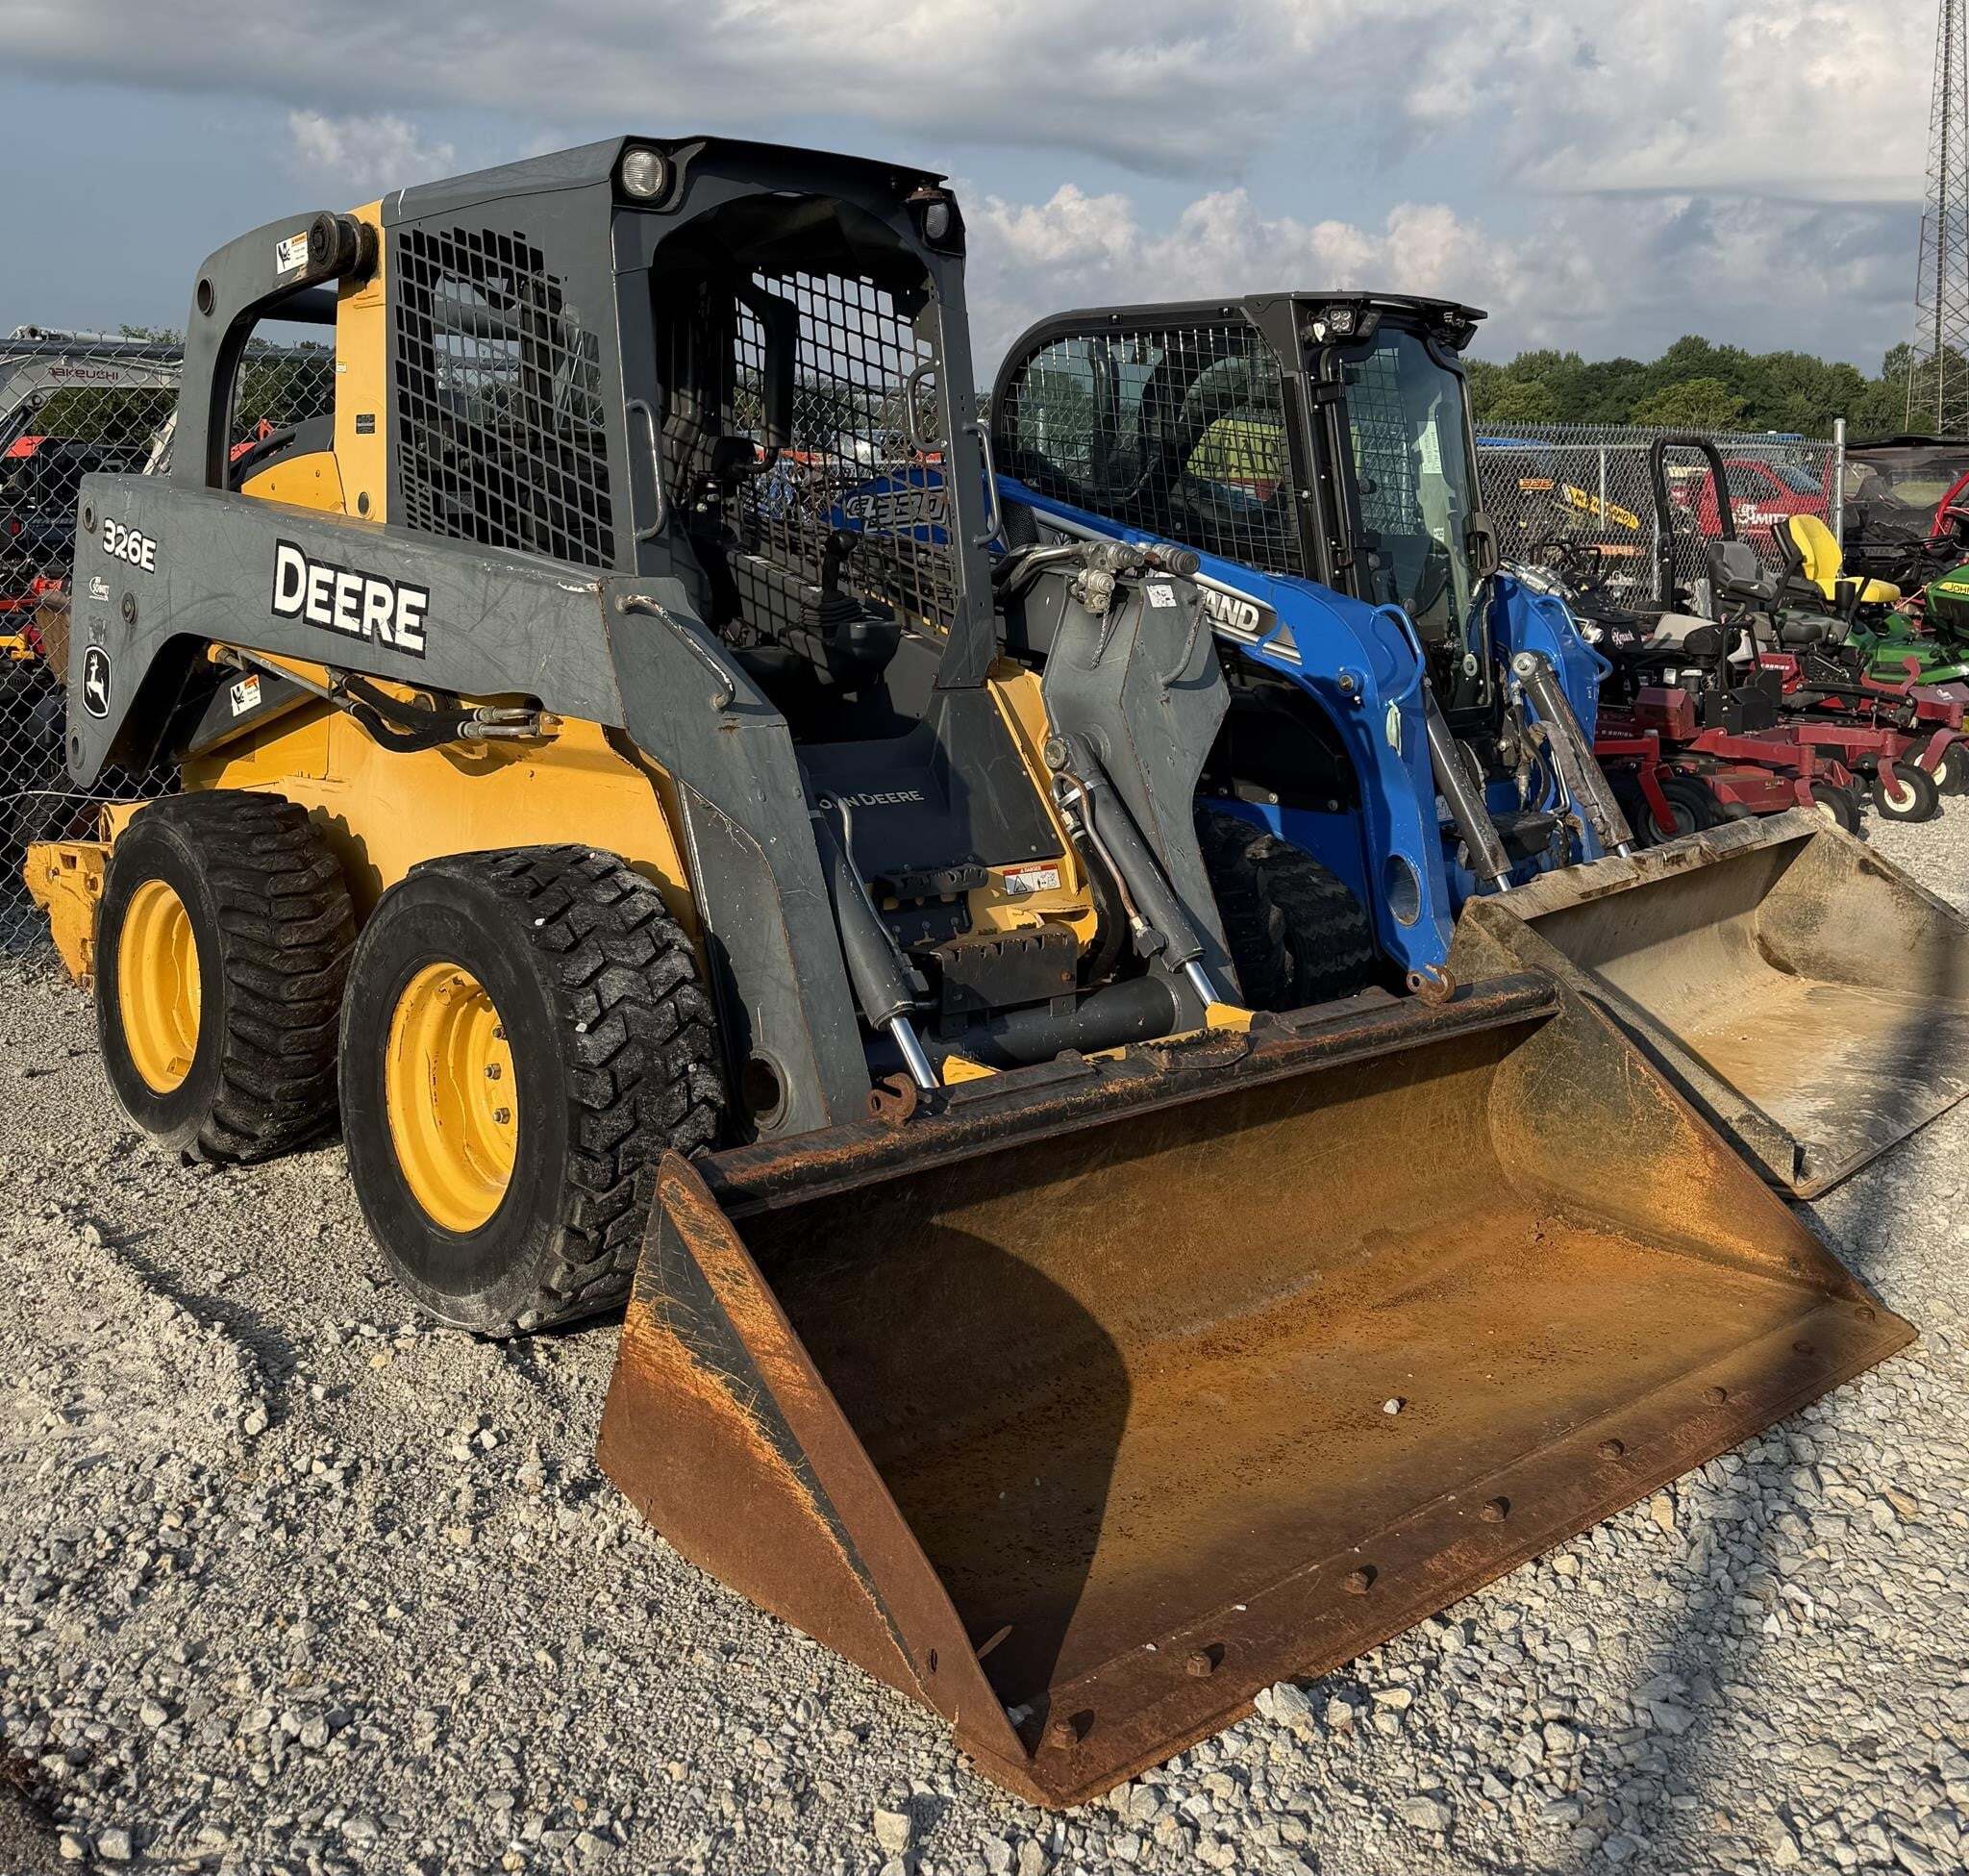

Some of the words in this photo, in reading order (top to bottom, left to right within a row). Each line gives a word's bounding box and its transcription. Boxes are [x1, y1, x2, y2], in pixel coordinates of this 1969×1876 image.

[103, 517, 157, 573] 326E
[274, 540, 428, 656] DEERE
[1204, 588, 1259, 633] AND
[858, 788, 925, 807] DEERE
